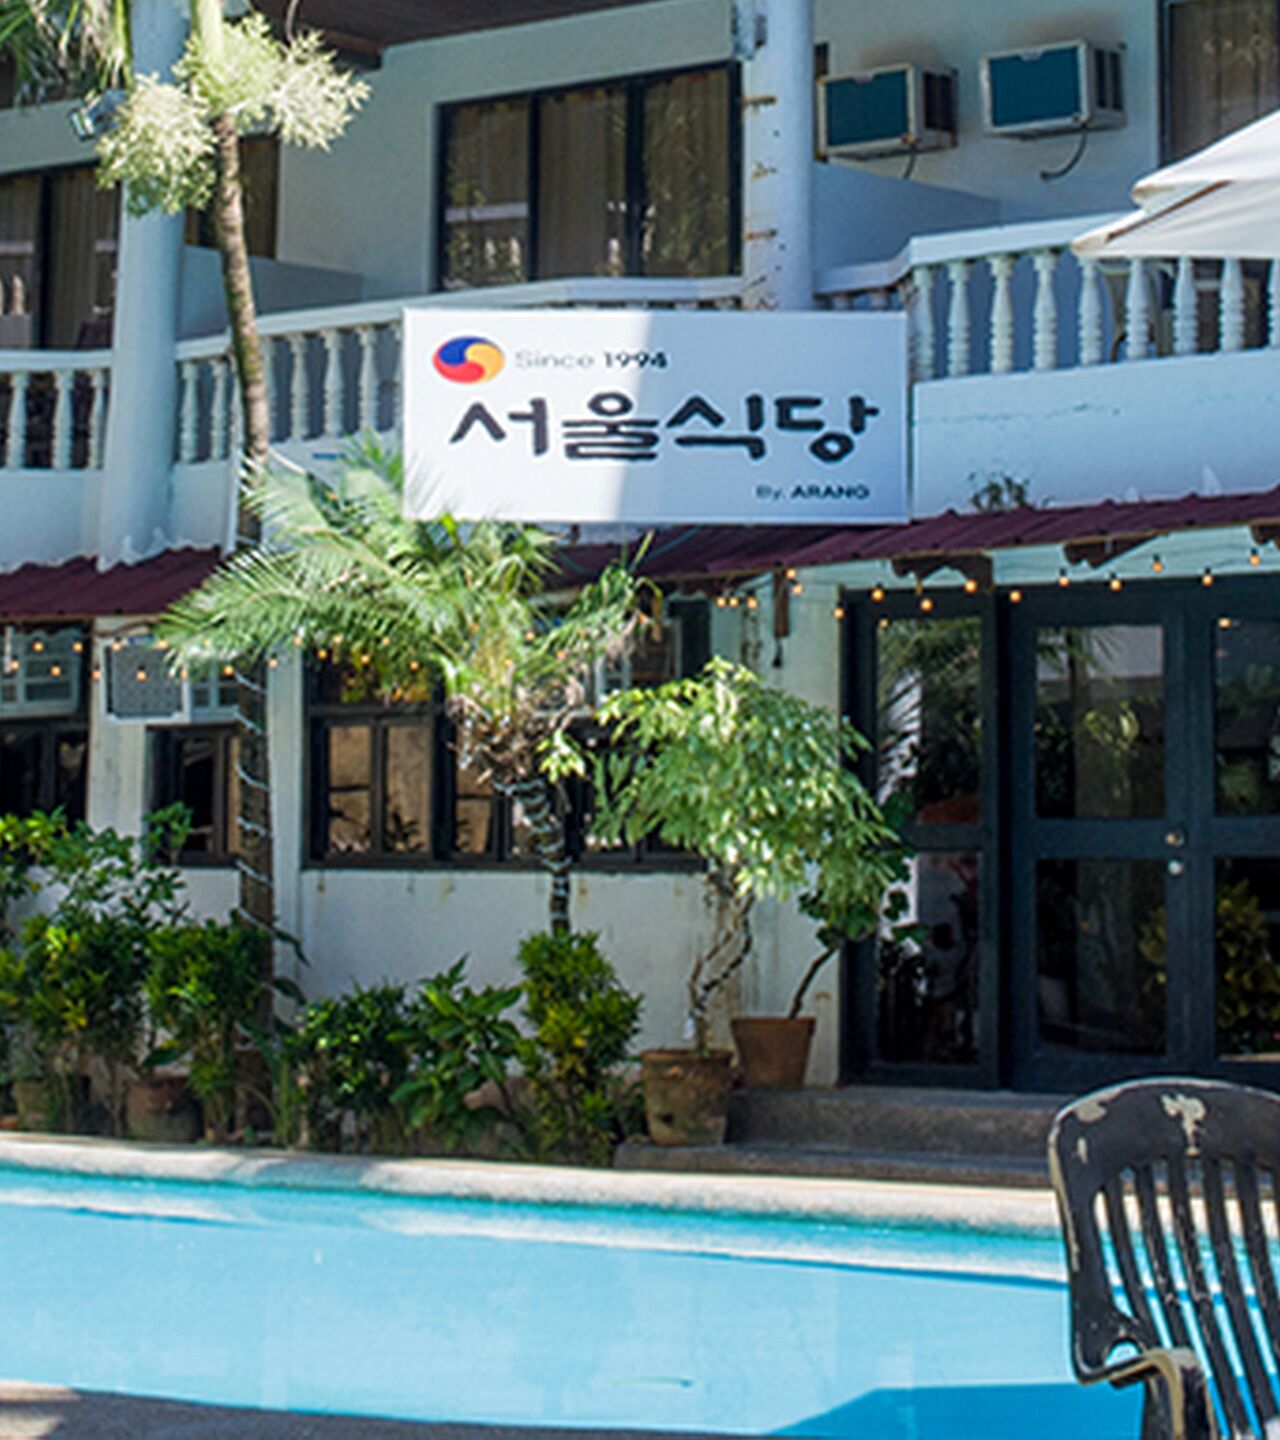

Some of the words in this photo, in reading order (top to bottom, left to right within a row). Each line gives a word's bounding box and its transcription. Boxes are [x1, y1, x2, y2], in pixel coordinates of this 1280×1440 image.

[515, 351, 594, 369] Since
[603, 350, 668, 368] 1994
[449, 392, 879, 461] 서울식당
